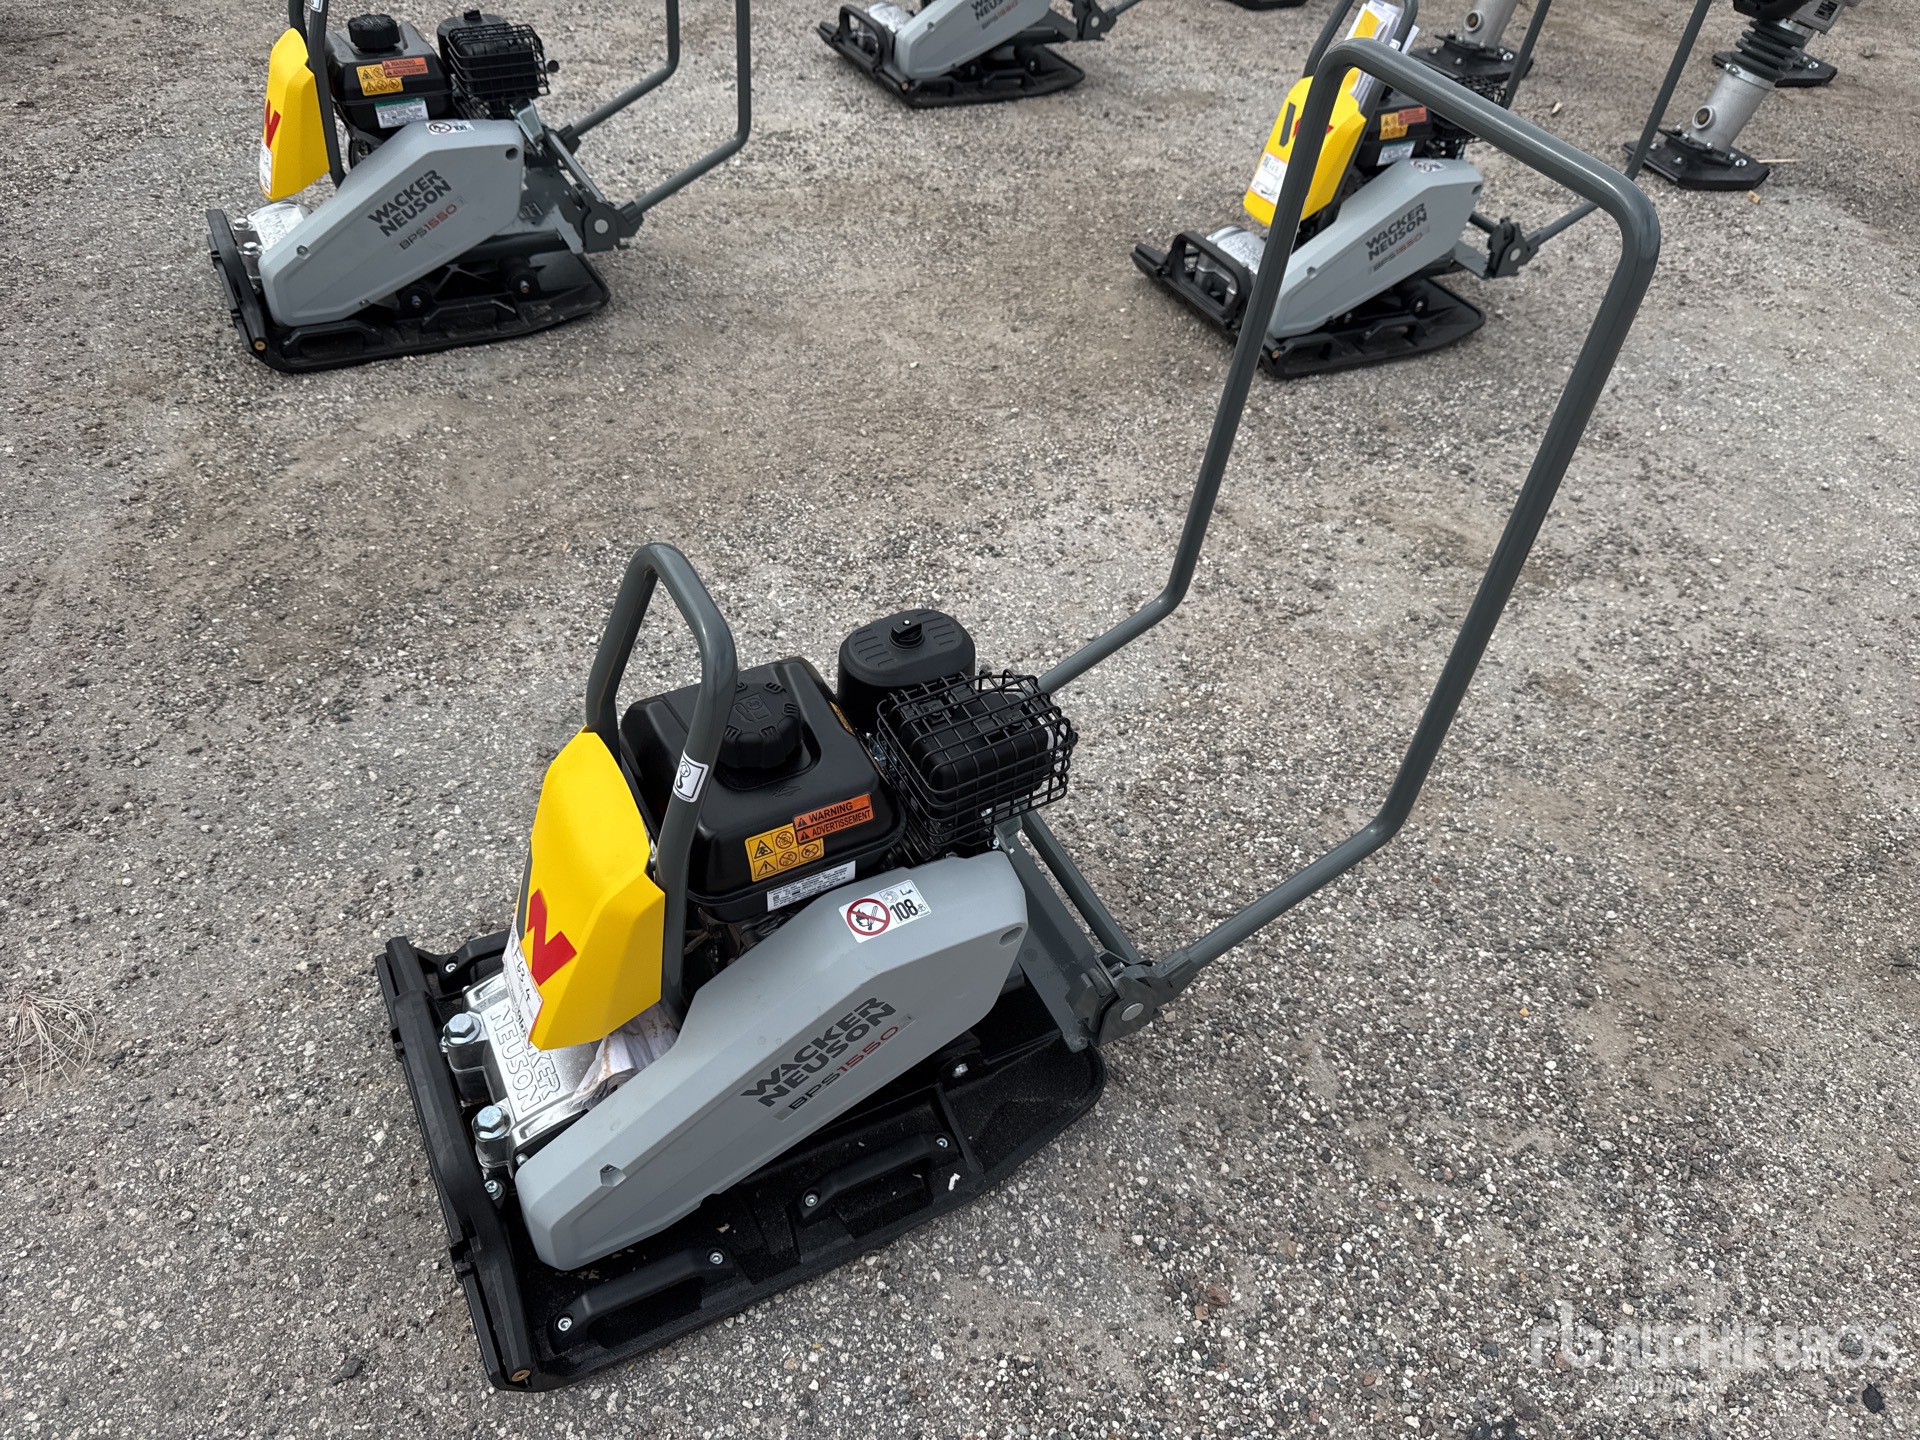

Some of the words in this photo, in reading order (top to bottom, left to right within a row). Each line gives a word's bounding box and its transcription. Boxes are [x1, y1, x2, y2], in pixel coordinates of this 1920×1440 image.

[367, 169, 443, 224] WACKER
[379, 178, 452, 238] NEUSON
[399, 203, 458, 251] BPS1550
[1365, 202, 1426, 249] WACKER
[1368, 211, 1428, 261] NEUSON
[808, 801, 853, 823] WARNING
[812, 809, 871, 837] ADVERTISSEMENT
[889, 898, 918, 921] 108
[489, 1005, 542, 1113] NEUSON
[525, 1043, 561, 1101] KER
[740, 997, 885, 1097] WACKER
[757, 1003, 896, 1108] NEUSON
[788, 1025, 899, 1110] BPS1550
